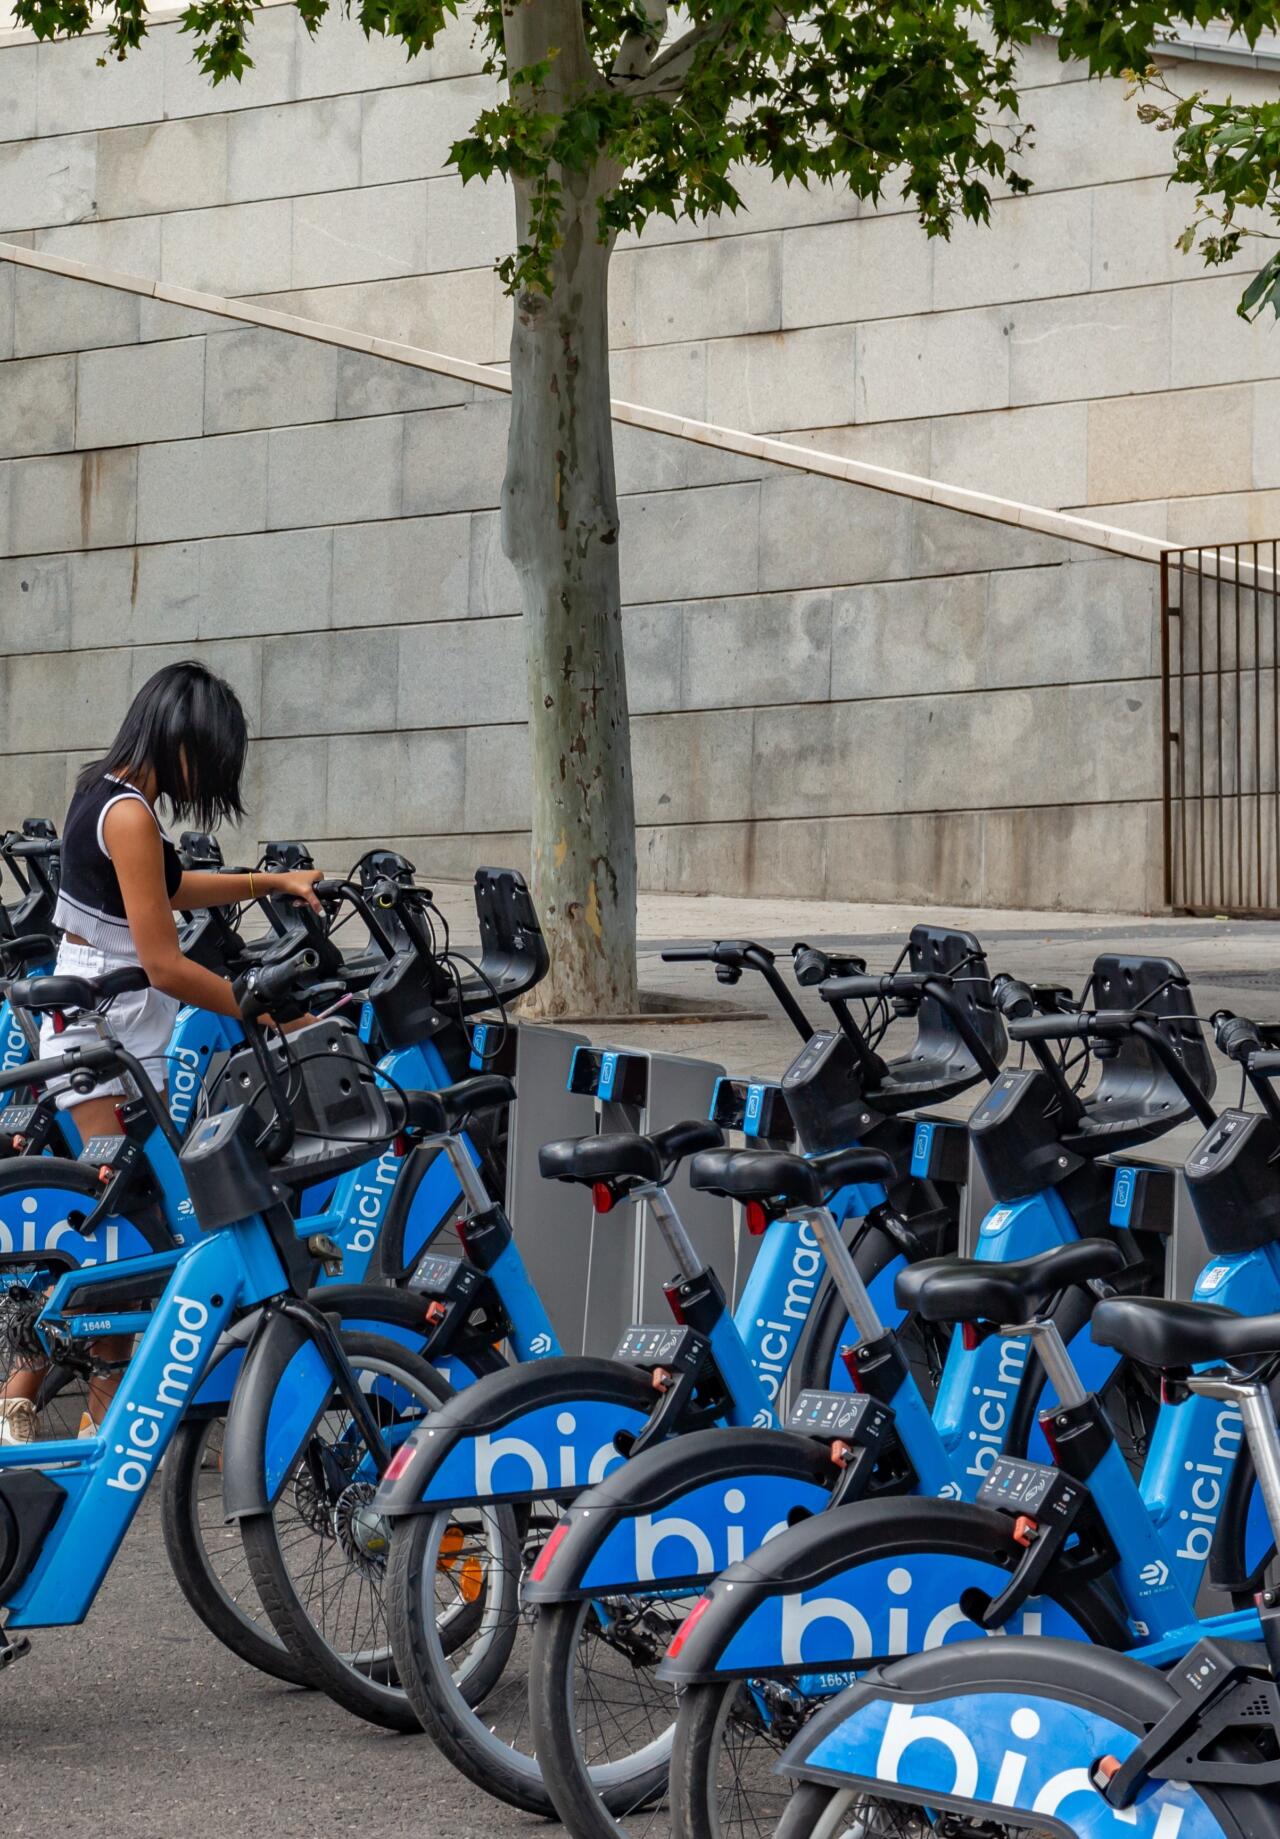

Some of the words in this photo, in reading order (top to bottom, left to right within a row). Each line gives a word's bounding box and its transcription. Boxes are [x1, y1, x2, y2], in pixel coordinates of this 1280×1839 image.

[170, 1047, 199, 1123] mad
[347, 1184, 383, 1252] bici
[83, 1320, 111, 1331] 16448
[106, 1402, 164, 1492] bici
[156, 1296, 208, 1408] mad
[966, 1386, 1007, 1477] bici
[1176, 1461, 1223, 1561] bici
